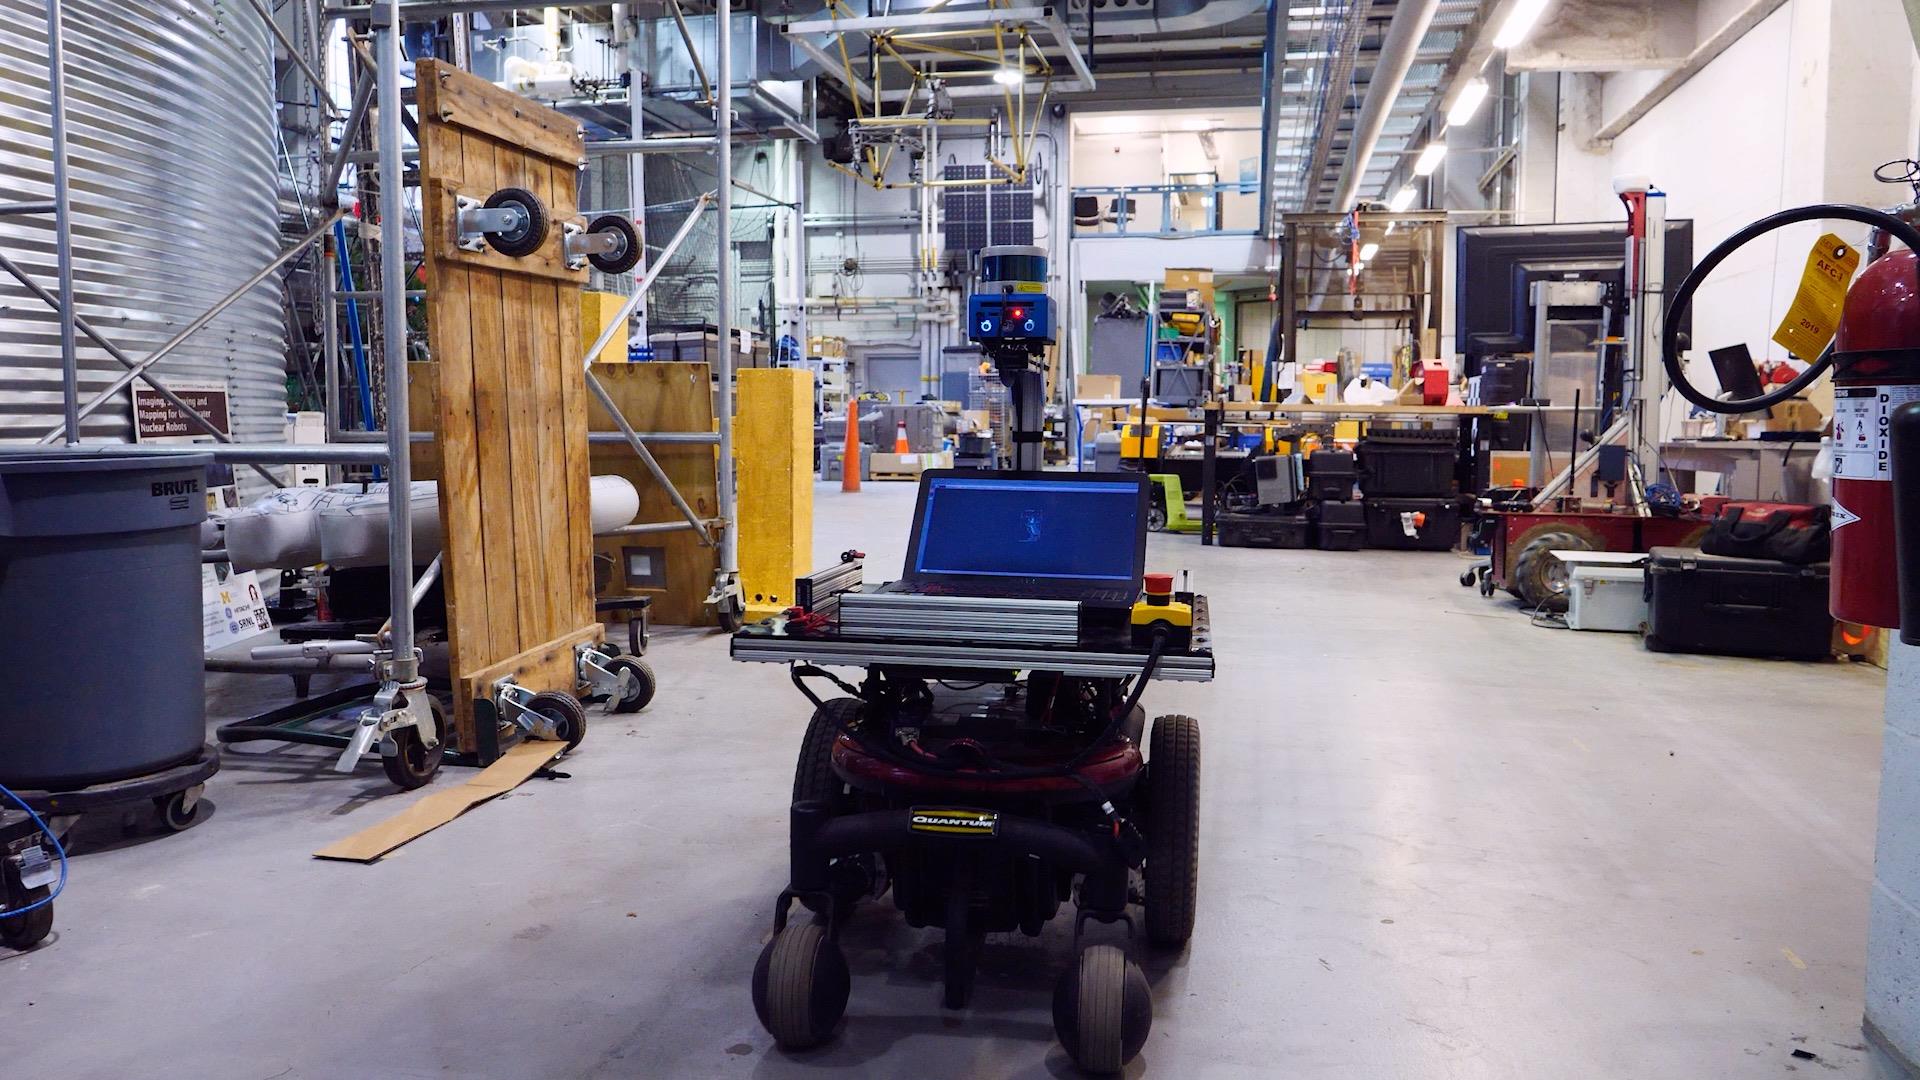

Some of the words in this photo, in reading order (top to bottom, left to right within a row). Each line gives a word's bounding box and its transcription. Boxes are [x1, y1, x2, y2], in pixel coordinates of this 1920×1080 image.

[1800, 318, 1820, 334] 2019
[138, 397, 167, 408] Imaging,
[197, 396, 208, 406] and
[139, 410, 167, 420] Mapping
[168, 409, 178, 418] for
[140, 422, 165, 432] Nuclear
[166, 422, 187, 432] Robots
[1878, 393, 1890, 471] DIOXIDE
[152, 479, 199, 496] BRUTE
[220, 591, 231, 604] M
[234, 604, 250, 614] HITACHI
[238, 617, 255, 629] SRNL
[912, 816, 992, 827] QUANTUM
